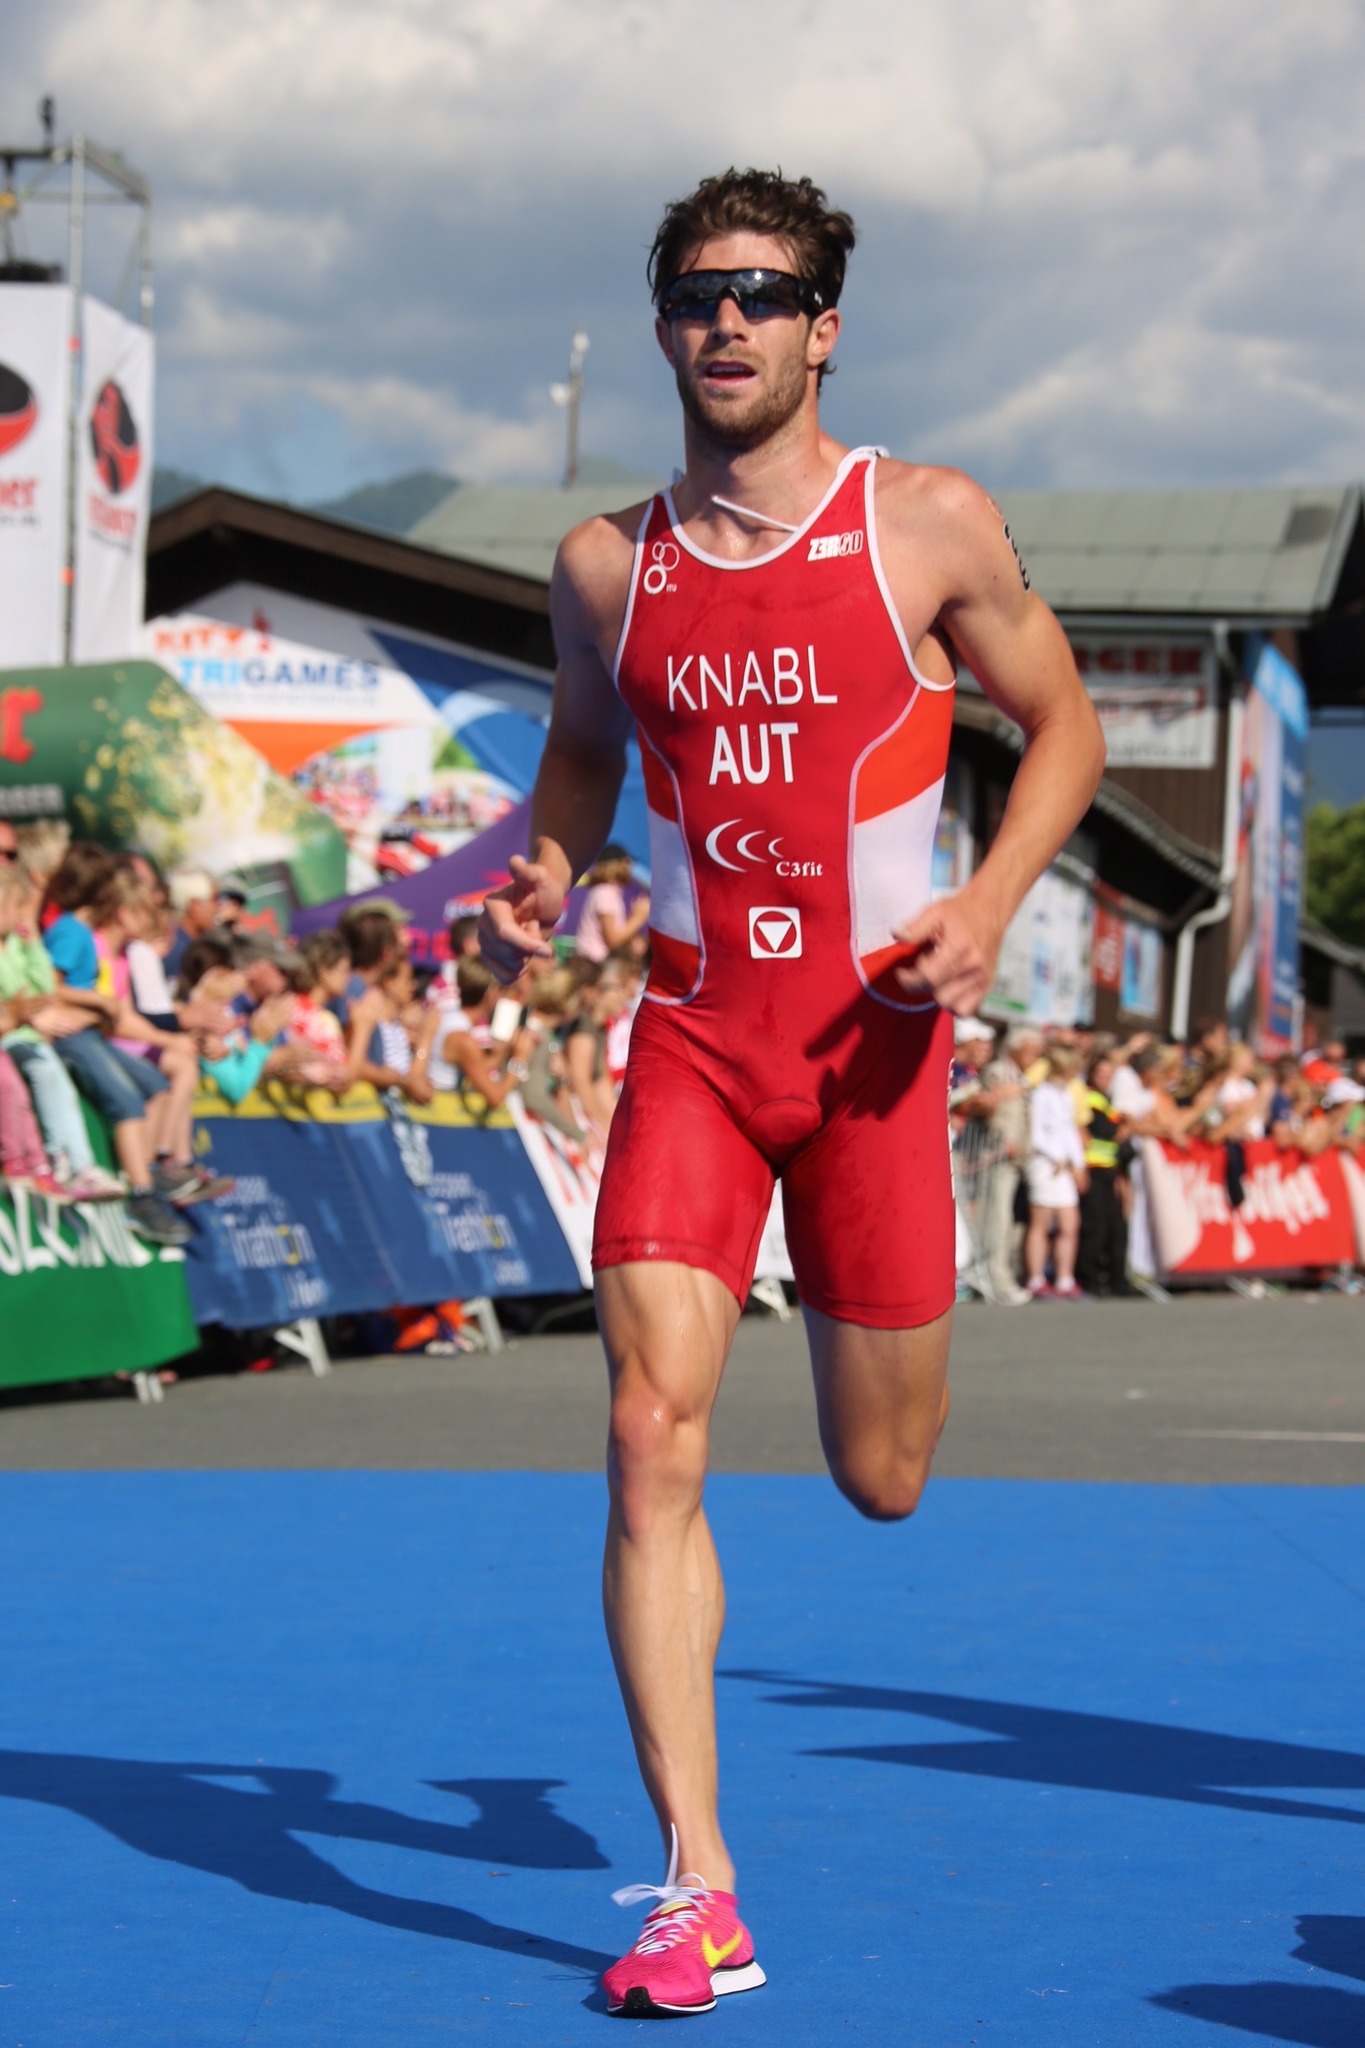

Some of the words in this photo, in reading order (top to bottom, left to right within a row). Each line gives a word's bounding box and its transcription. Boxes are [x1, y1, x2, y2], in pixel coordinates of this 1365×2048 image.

[178, 656, 381, 690] TRIGAMES
[666, 644, 839, 713] KNABL
[708, 722, 800, 786] AUT
[775, 859, 824, 878] C3fit
